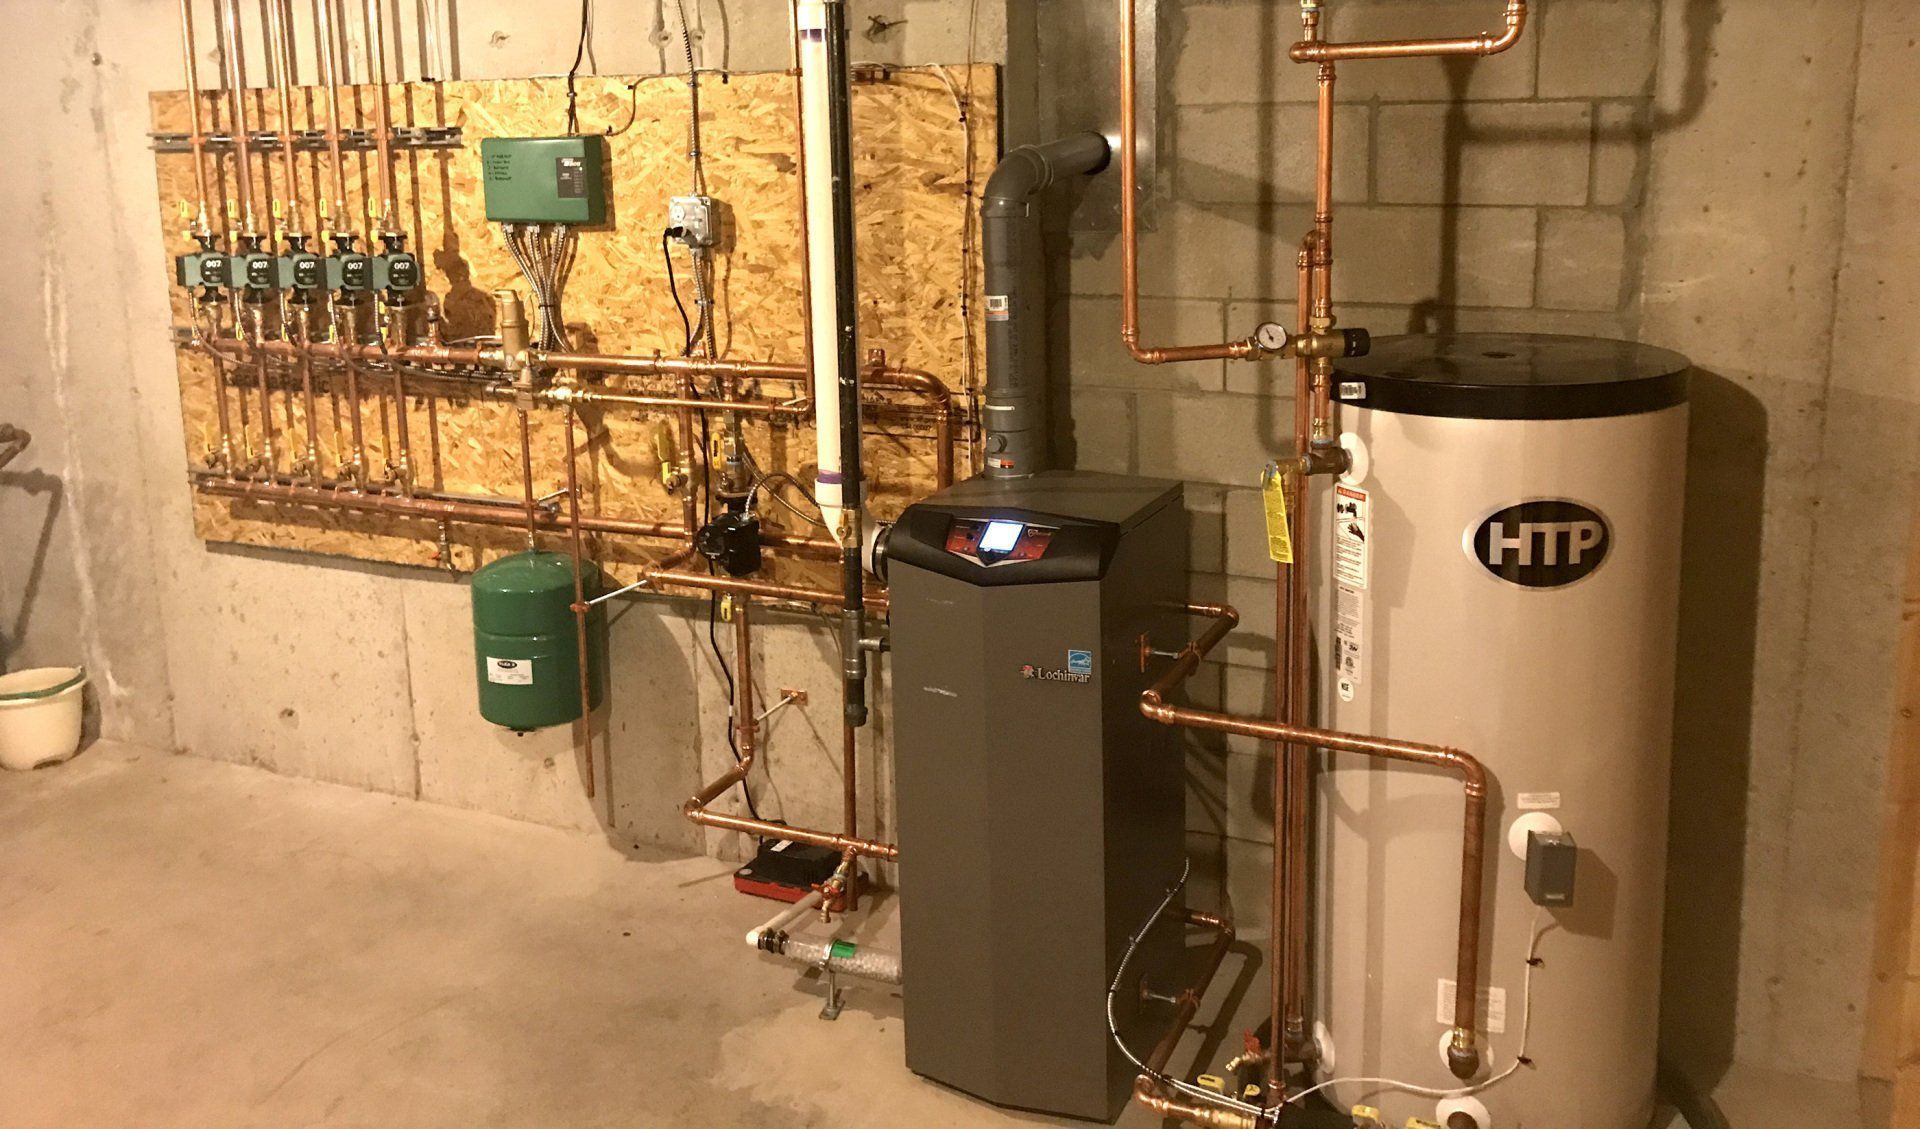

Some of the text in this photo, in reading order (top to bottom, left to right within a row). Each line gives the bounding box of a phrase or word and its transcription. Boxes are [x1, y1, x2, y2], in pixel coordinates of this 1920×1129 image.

[206, 260, 221, 268] 007
[252, 261, 268, 269] 007
[299, 261, 315, 269] 007
[347, 262, 363, 270] 007
[394, 262, 410, 270] 007
[1489, 521, 1603, 566] HTP
[1037, 667, 1090, 683] Lochinvar
